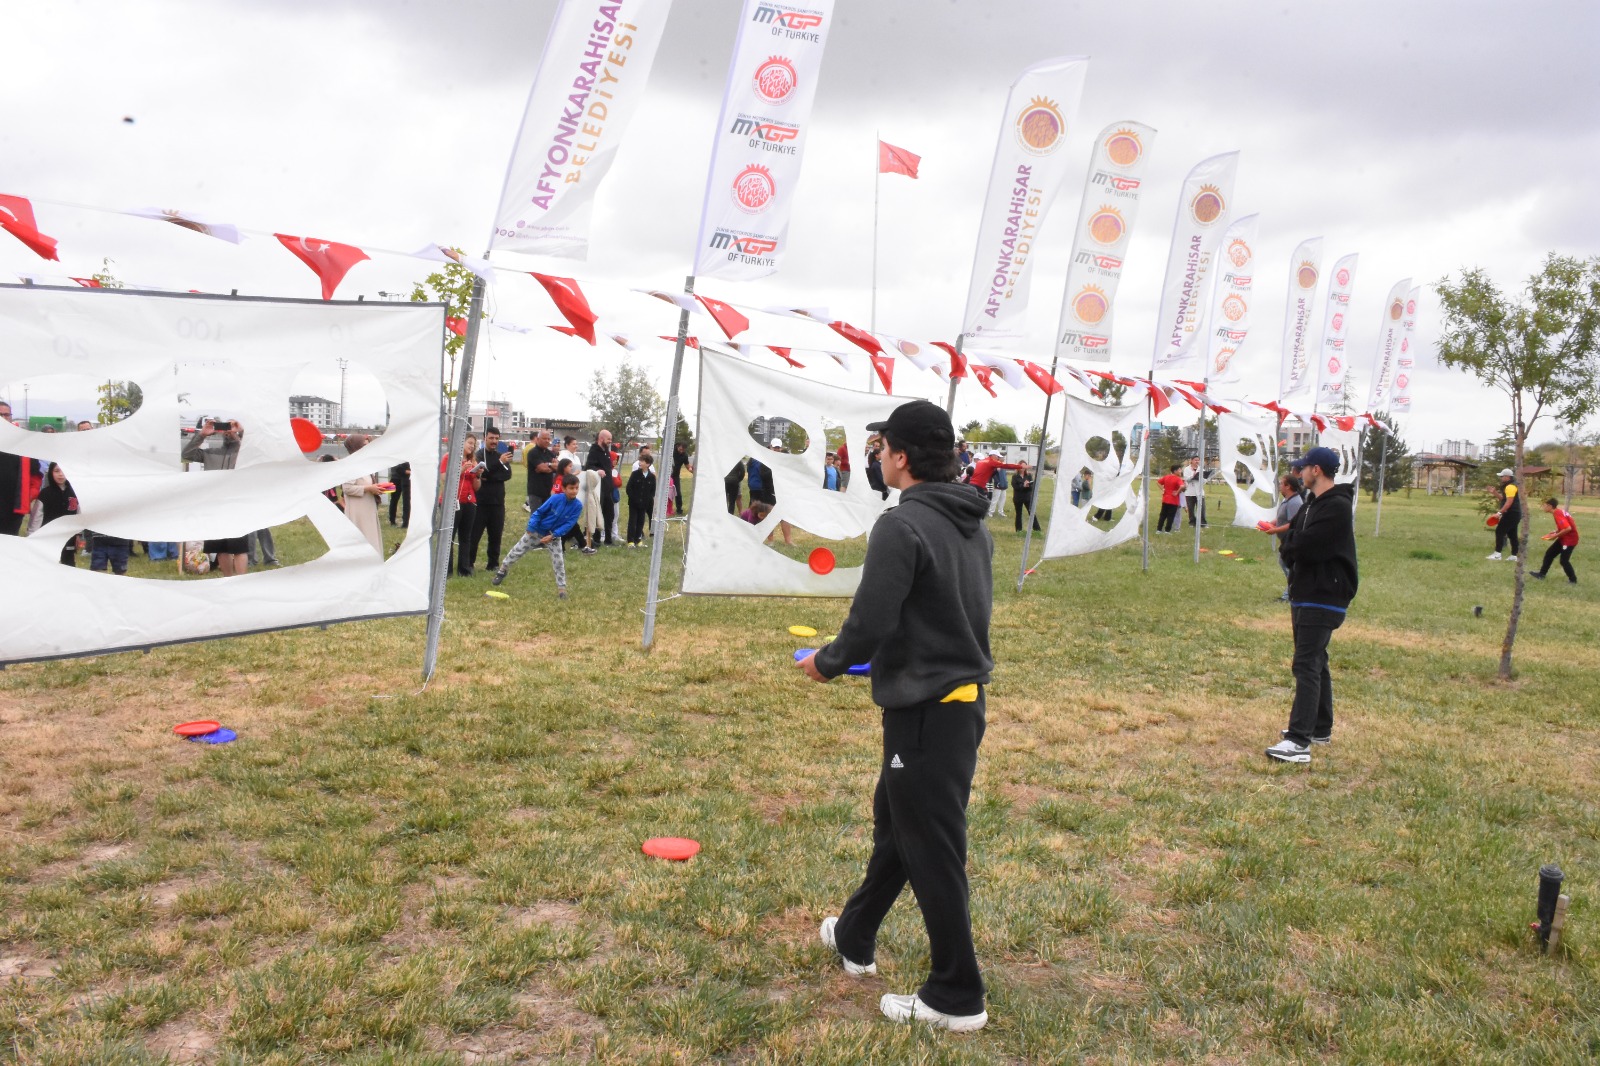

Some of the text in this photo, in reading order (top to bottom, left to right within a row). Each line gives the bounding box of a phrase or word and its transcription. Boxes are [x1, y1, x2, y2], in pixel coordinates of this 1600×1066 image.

[752, 6, 823, 30] MXGP
[772, 26, 820, 44] OF TÜRKİYE
[531, 0, 623, 210] AFYONKARAHİSA
[730, 118, 800, 143] MXGP
[748, 138, 797, 156] OF TÜRKİYE
[1092, 172, 1141, 191] MXGP
[709, 232, 778, 256] MXGP
[728, 252, 776, 266] OF TÜRKİYE
[1074, 252, 1122, 270] MXGP
[1060, 332, 1109, 348] MXGP
